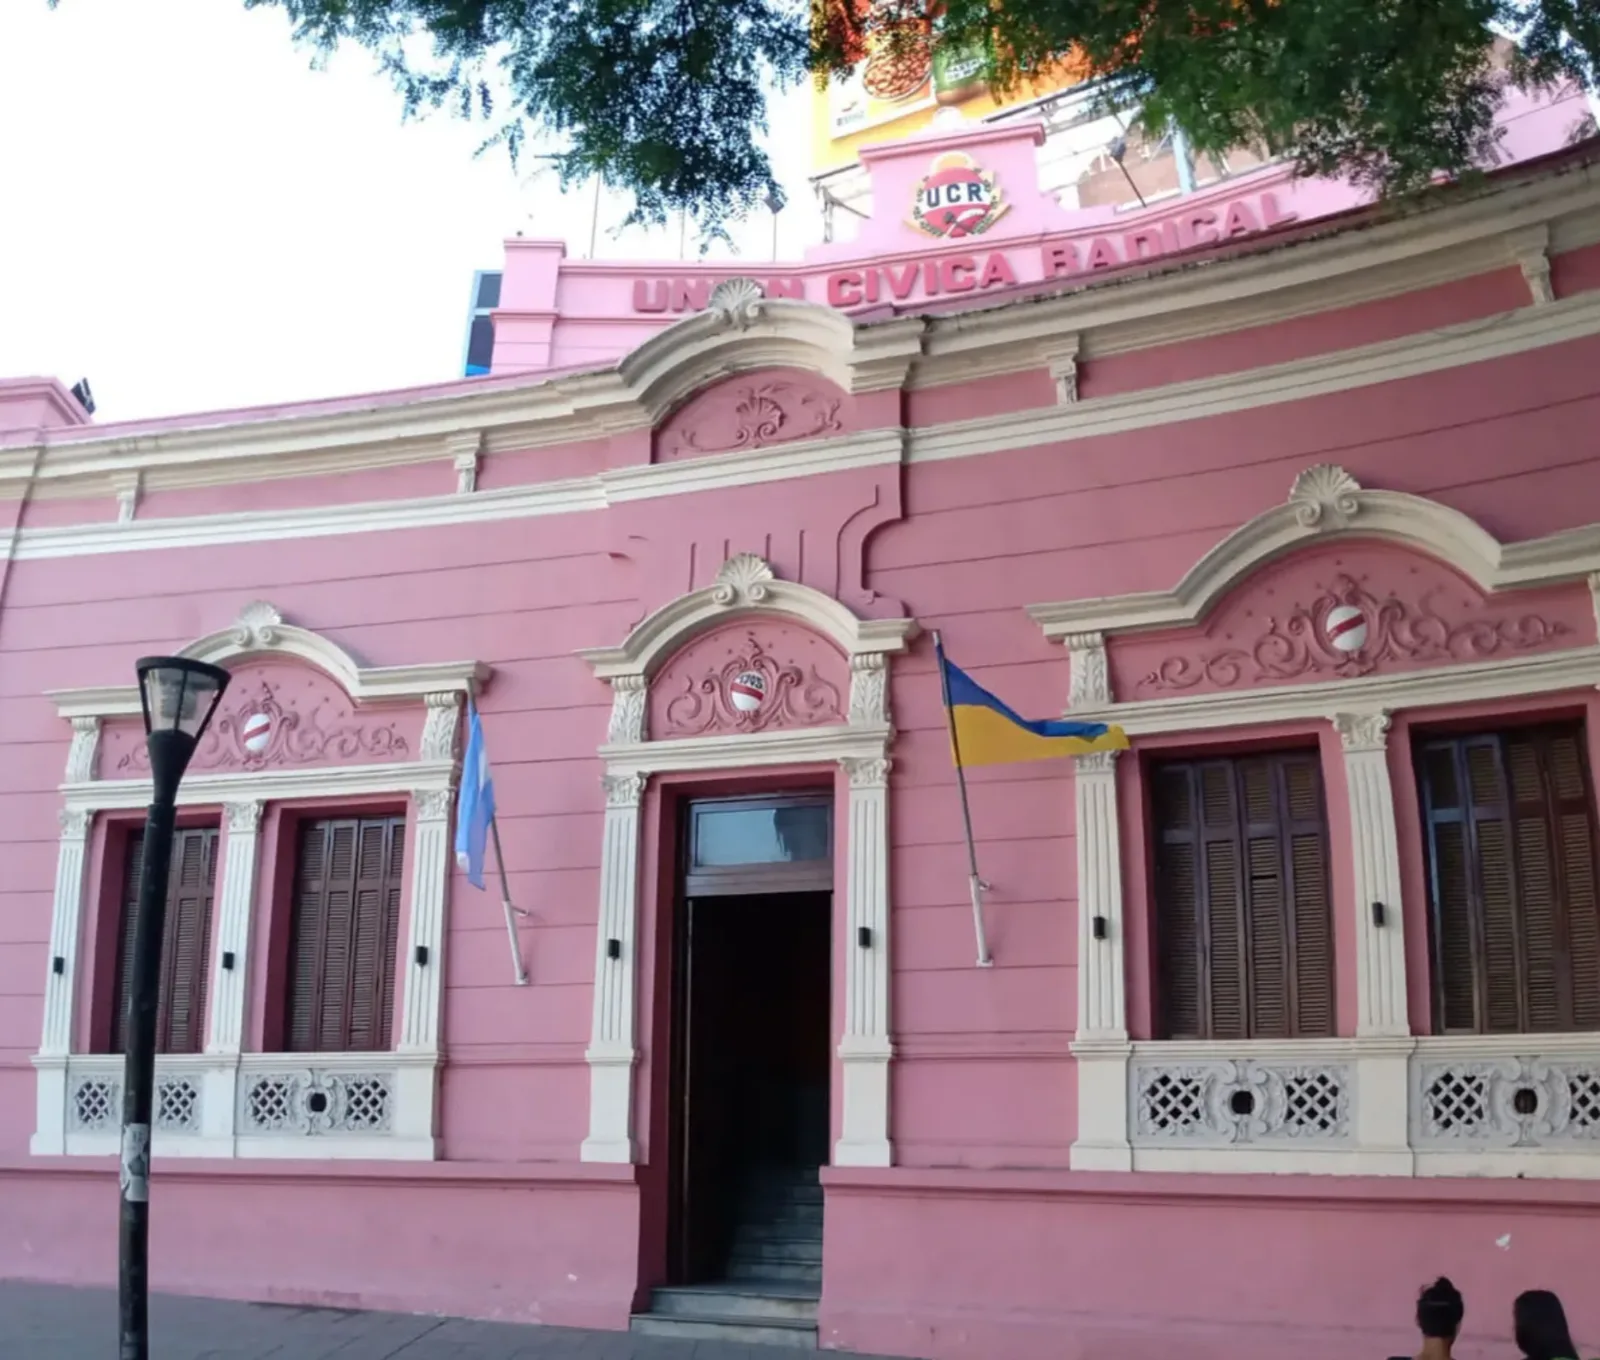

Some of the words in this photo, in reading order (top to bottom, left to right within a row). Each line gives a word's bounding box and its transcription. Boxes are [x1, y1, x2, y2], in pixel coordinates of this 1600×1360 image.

[926, 182, 983, 208] UCR
[633, 279, 805, 313] UNN
[827, 251, 1017, 308] CIVICA
[1040, 192, 1298, 279] RADICAL
